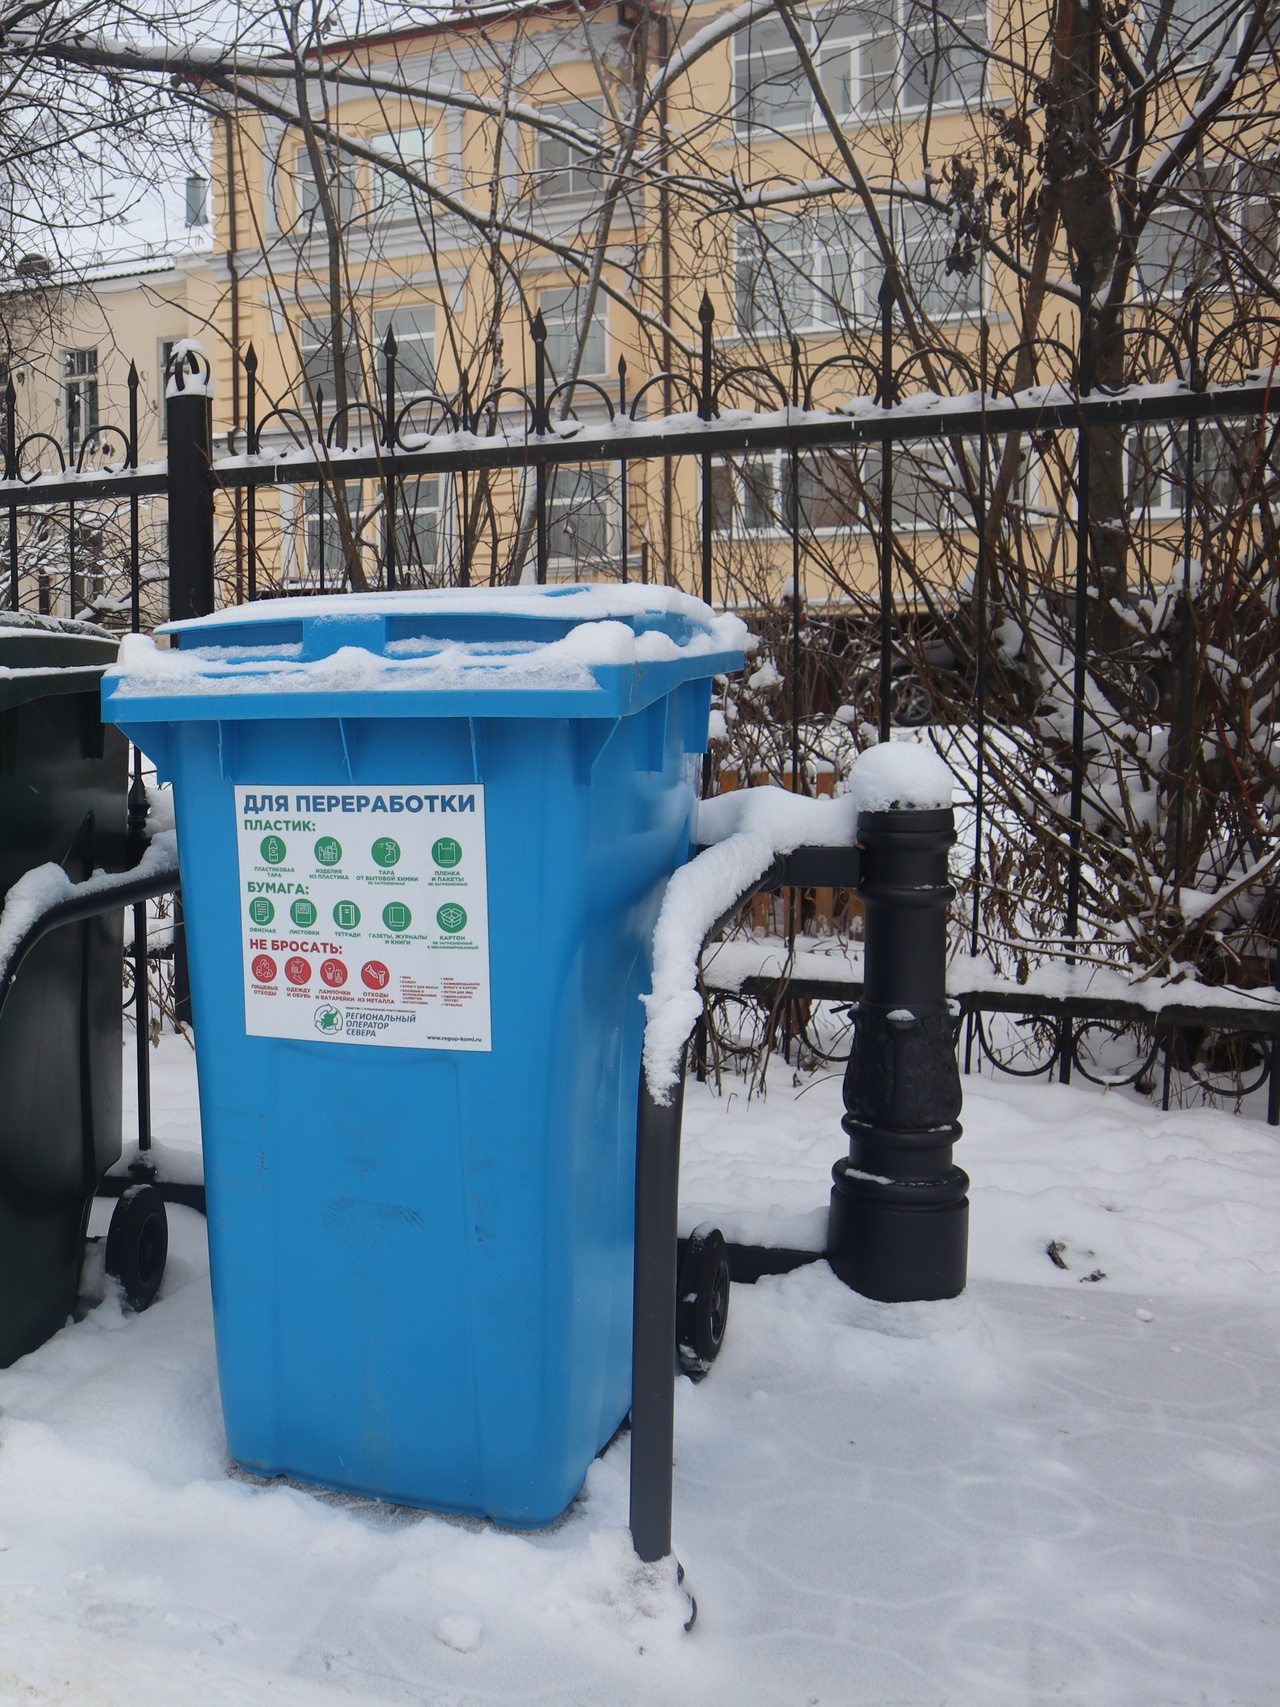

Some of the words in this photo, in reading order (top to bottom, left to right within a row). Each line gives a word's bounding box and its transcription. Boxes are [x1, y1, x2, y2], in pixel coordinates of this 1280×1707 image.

[244, 795, 289, 814] ДЛЯ
[296, 795, 475, 813] ПЕРЕРАБОТКИ
[244, 819, 316, 832] ПЛАСТИК:
[247, 881, 309, 895] БУМАГА:
[250, 938, 268, 950] НЕ
[271, 940, 342, 954] БРОСАТЬ:
[321, 994, 355, 1002] БАТАРЕЙКИ
[345, 1011, 416, 1023] РЕГИОНАЛЬНЫЙ
[346, 1020, 389, 1030] ОПЕРАТОР
[346, 1028, 376, 1037] СЕВЕРА
